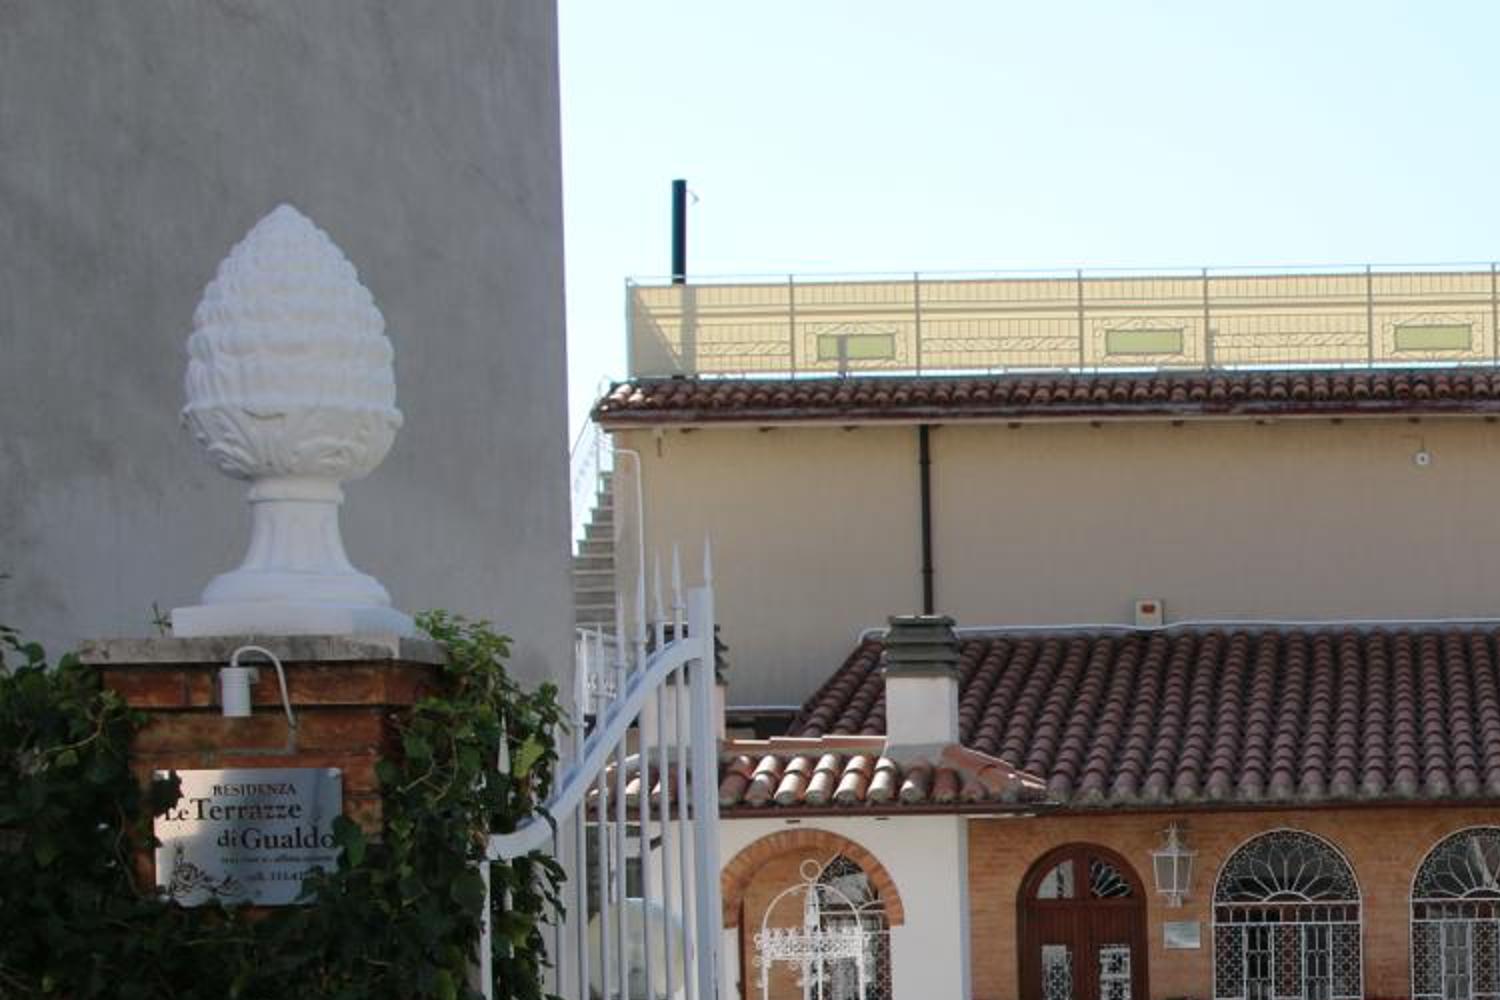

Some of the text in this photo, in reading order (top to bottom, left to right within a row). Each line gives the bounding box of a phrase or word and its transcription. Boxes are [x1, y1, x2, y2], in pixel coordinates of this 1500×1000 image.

[213, 783, 297, 797] RESIDENZA
[165, 797, 302, 821] Le Terrazze
[217, 826, 335, 850] di Gualdo
